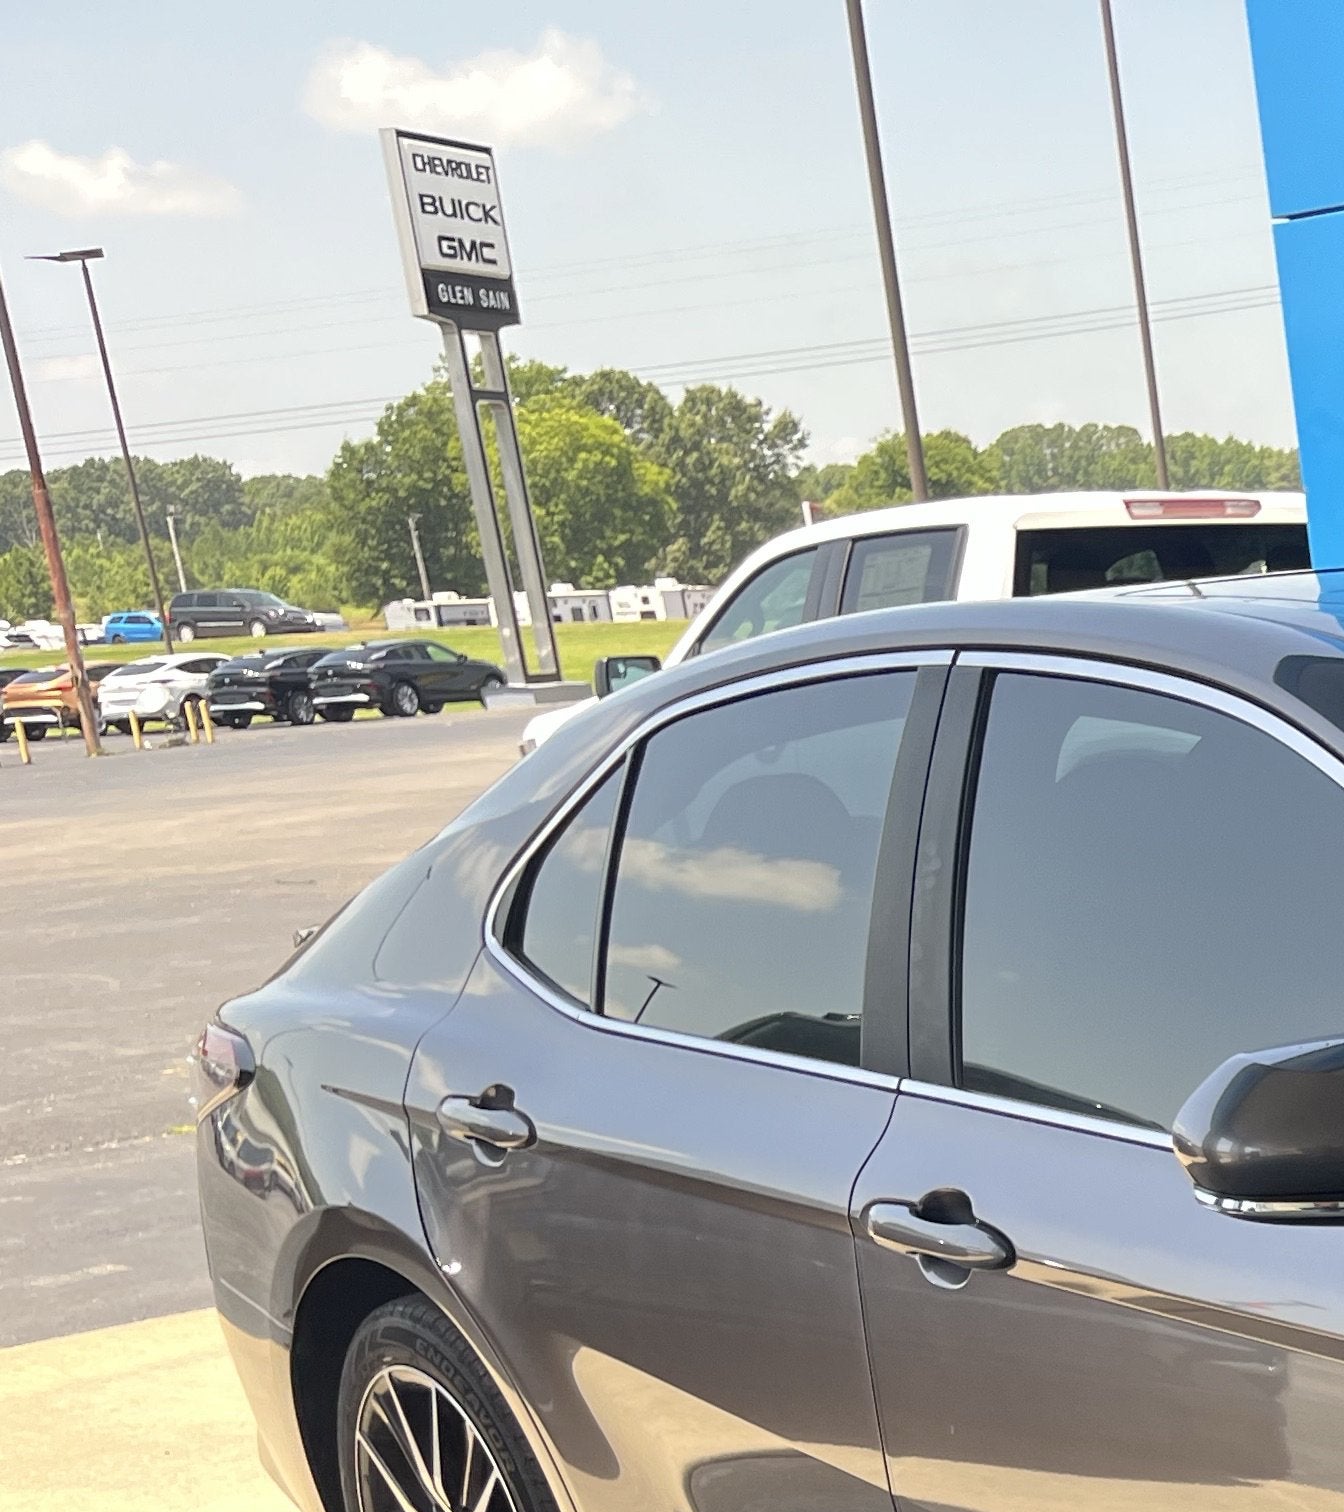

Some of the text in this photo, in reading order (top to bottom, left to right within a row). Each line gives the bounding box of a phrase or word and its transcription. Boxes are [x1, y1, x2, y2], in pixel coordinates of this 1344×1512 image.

[412, 153, 491, 184] CHEVROLET
[419, 193, 501, 225] BUICK
[437, 235, 498, 265] GMC
[437, 283, 511, 311] GLEN SAIN
